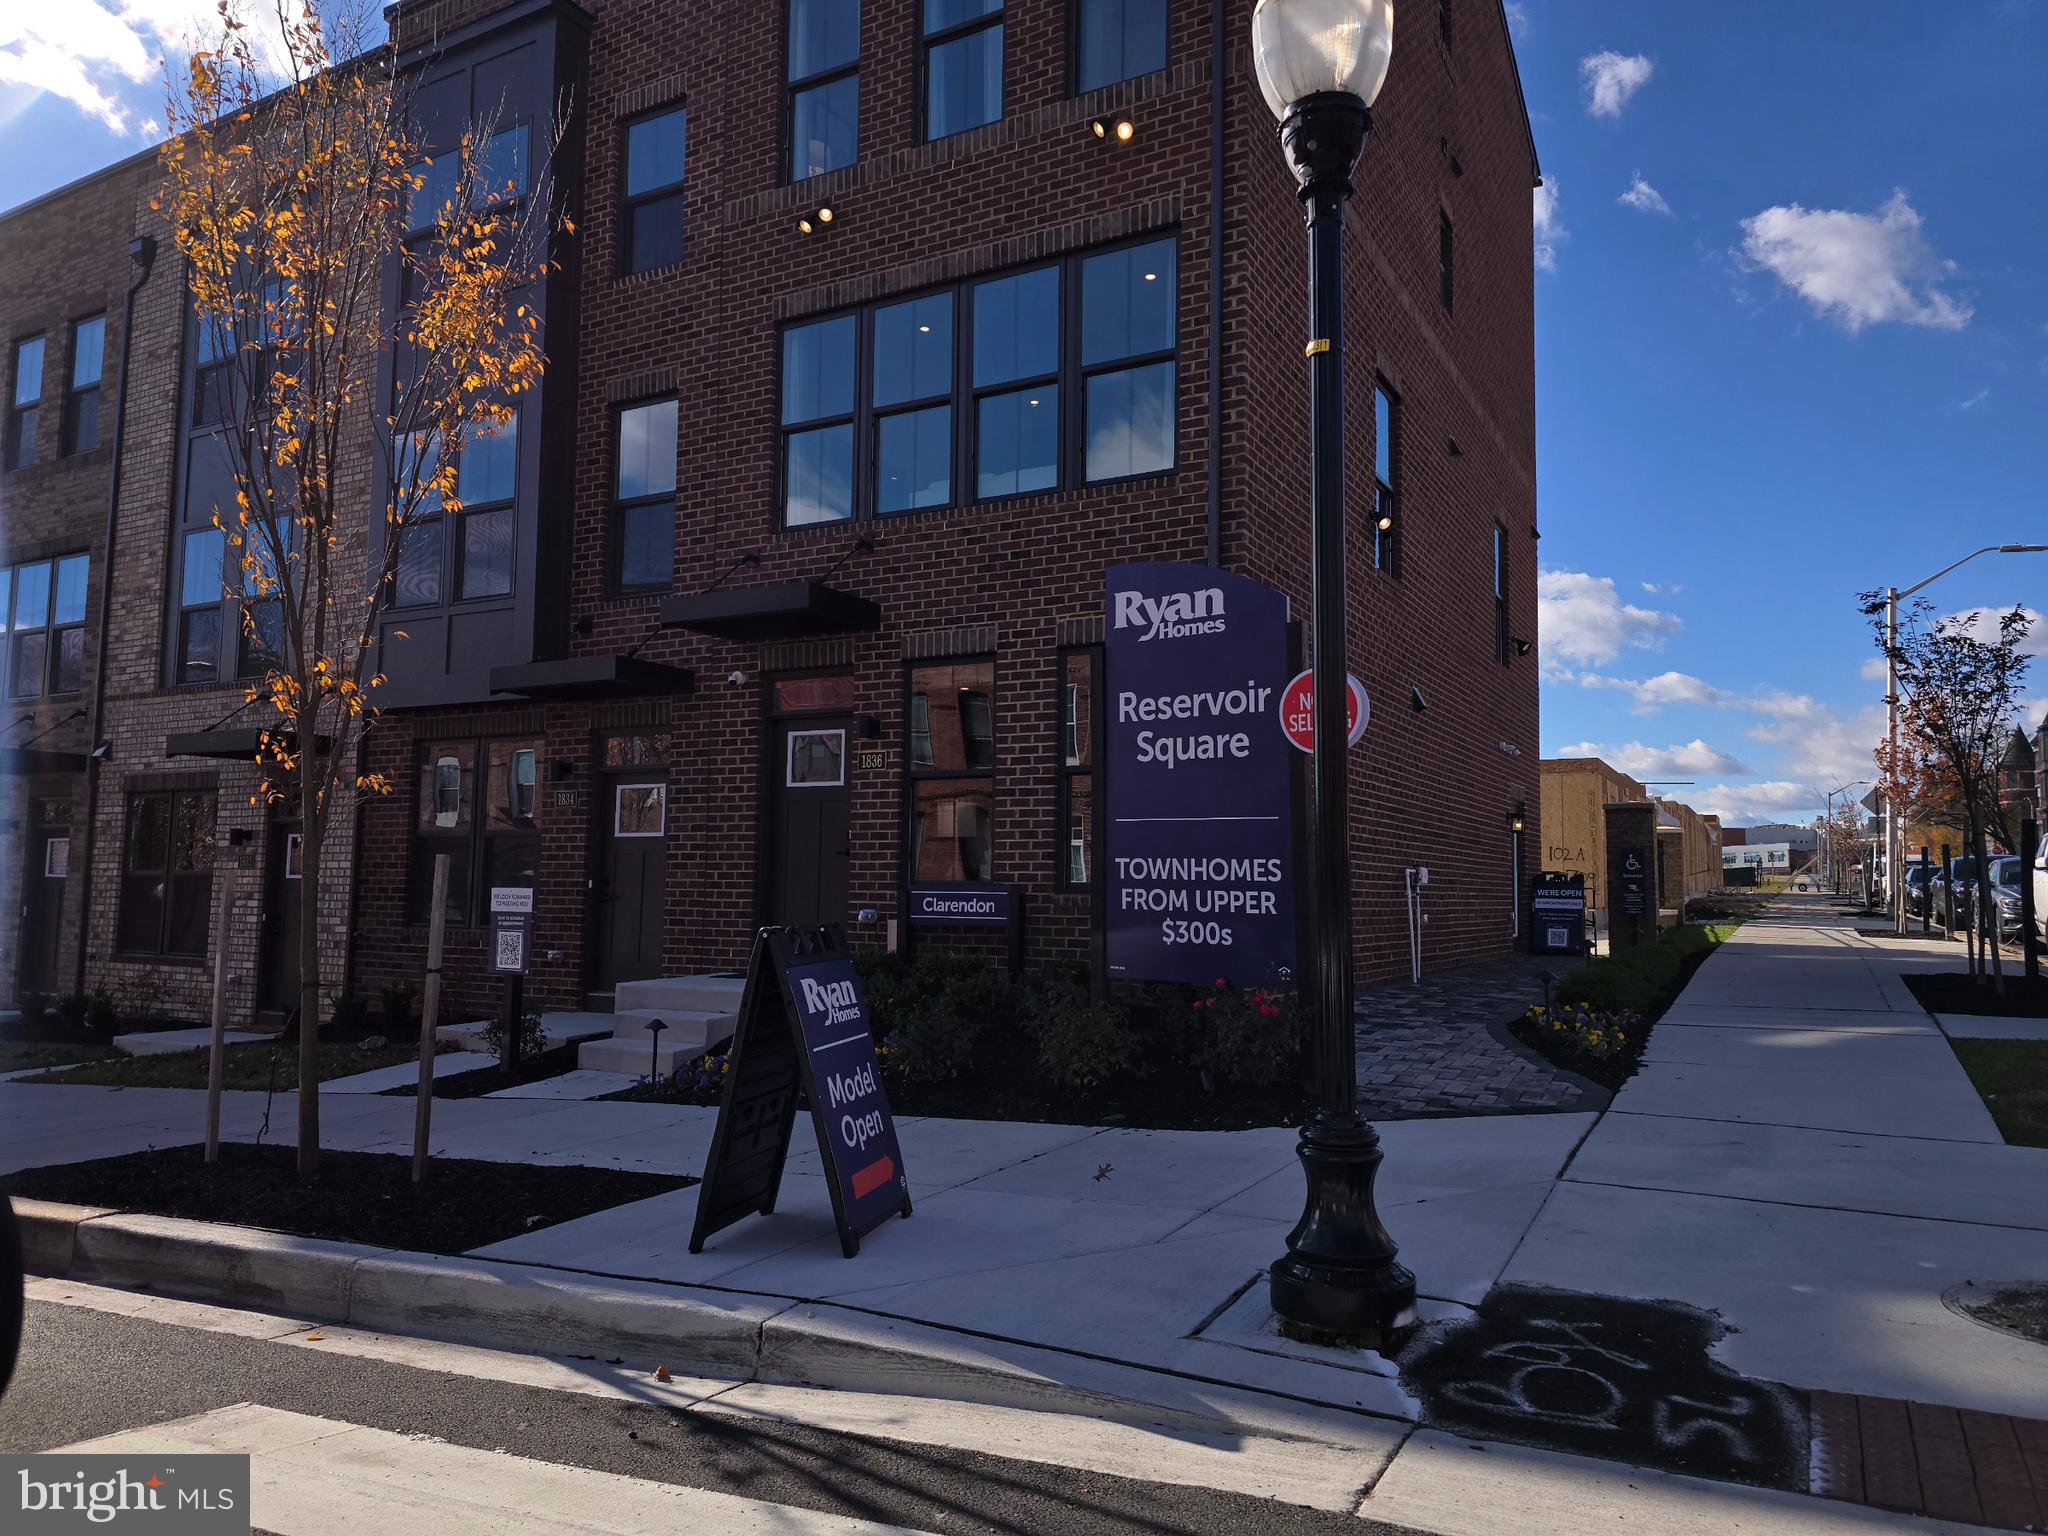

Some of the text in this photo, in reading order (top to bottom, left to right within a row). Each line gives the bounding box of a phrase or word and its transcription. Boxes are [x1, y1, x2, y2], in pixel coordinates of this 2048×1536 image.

[1113, 587, 1227, 643] Ryan
[1158, 618, 1227, 640] Homes
[1118, 679, 1272, 723] Reservoir
[861, 753, 884, 769] 1836
[1136, 730, 1250, 769] Square
[1549, 846, 1585, 862] 102 A
[1114, 857, 1283, 883] TOWNHOMES
[922, 897, 996, 914] Clarendon
[1121, 888, 1278, 915] FROM UPPER
[1560, 889, 1582, 897] OPEN
[1162, 917, 1233, 945] $300s
[799, 977, 857, 1027] Ryan
[831, 1005, 861, 1024] Homes
[826, 1061, 877, 1109] Model
[840, 1108, 884, 1151] Open
